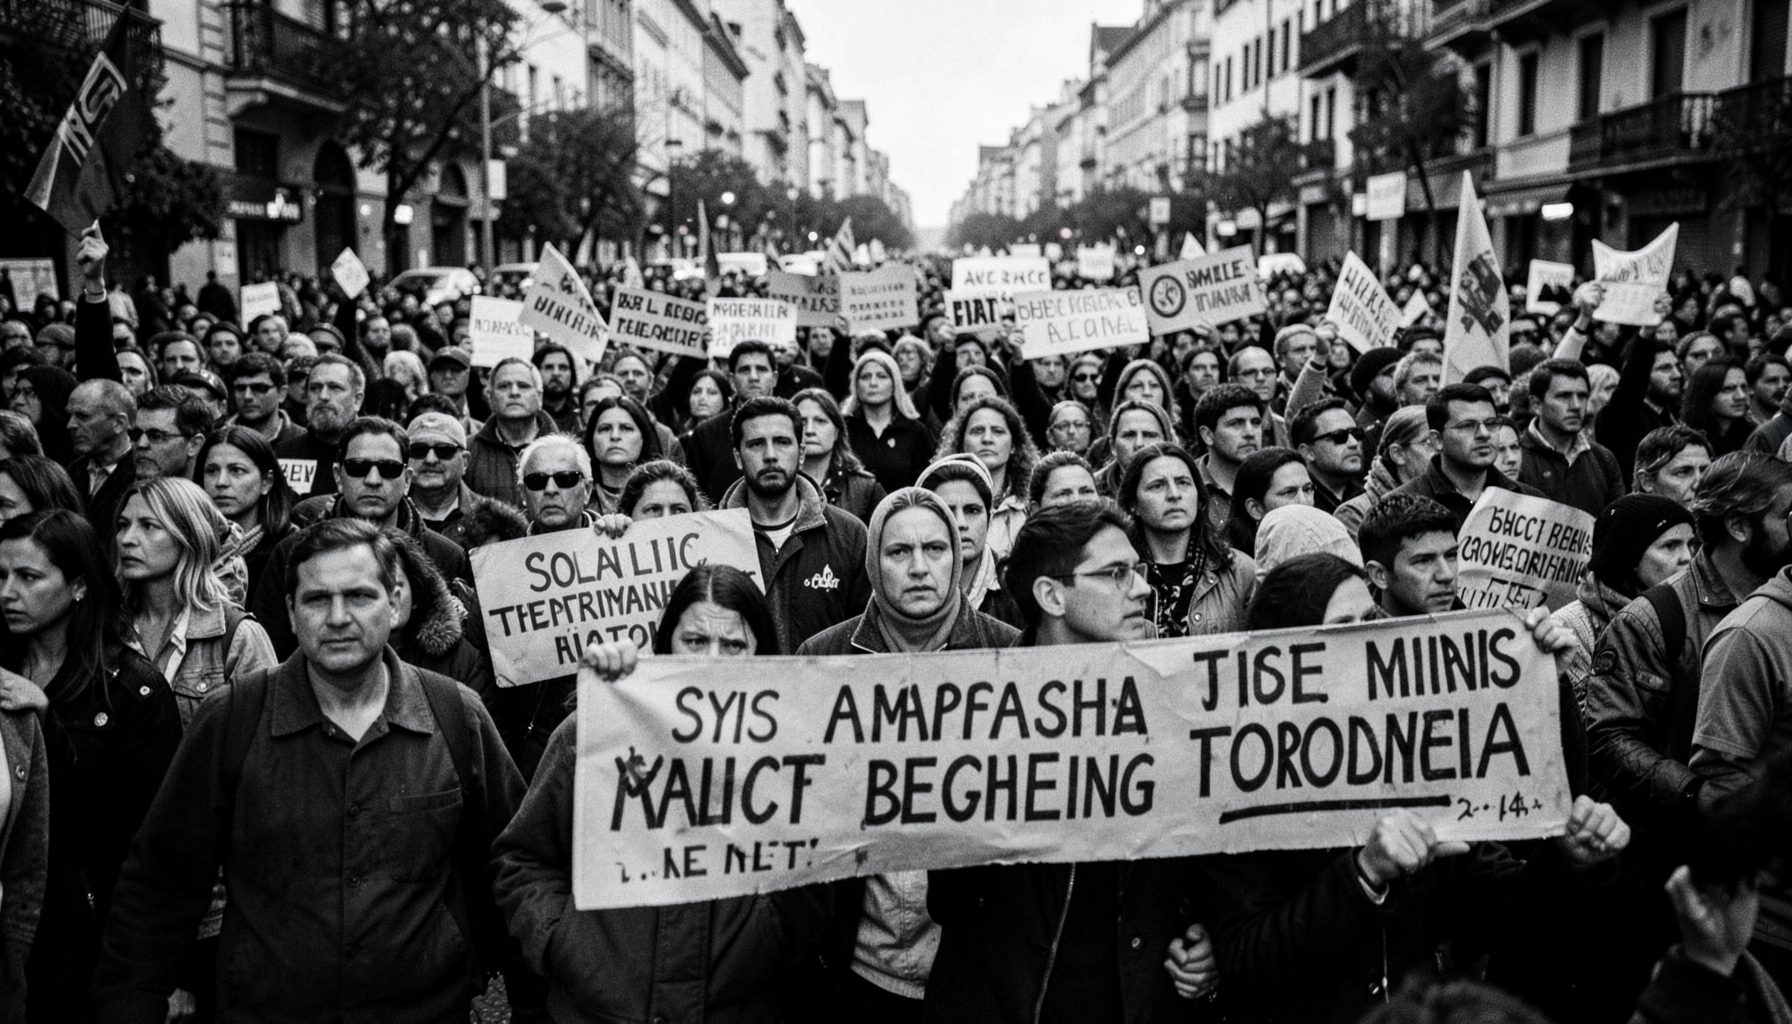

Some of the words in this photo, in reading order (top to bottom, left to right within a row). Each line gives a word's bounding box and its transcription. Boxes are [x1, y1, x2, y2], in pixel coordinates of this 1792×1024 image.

[671, 685, 780, 744] SYIS
[862, 751, 1157, 829] BEGHEING
[1189, 702, 1531, 798] TORODNEIA
